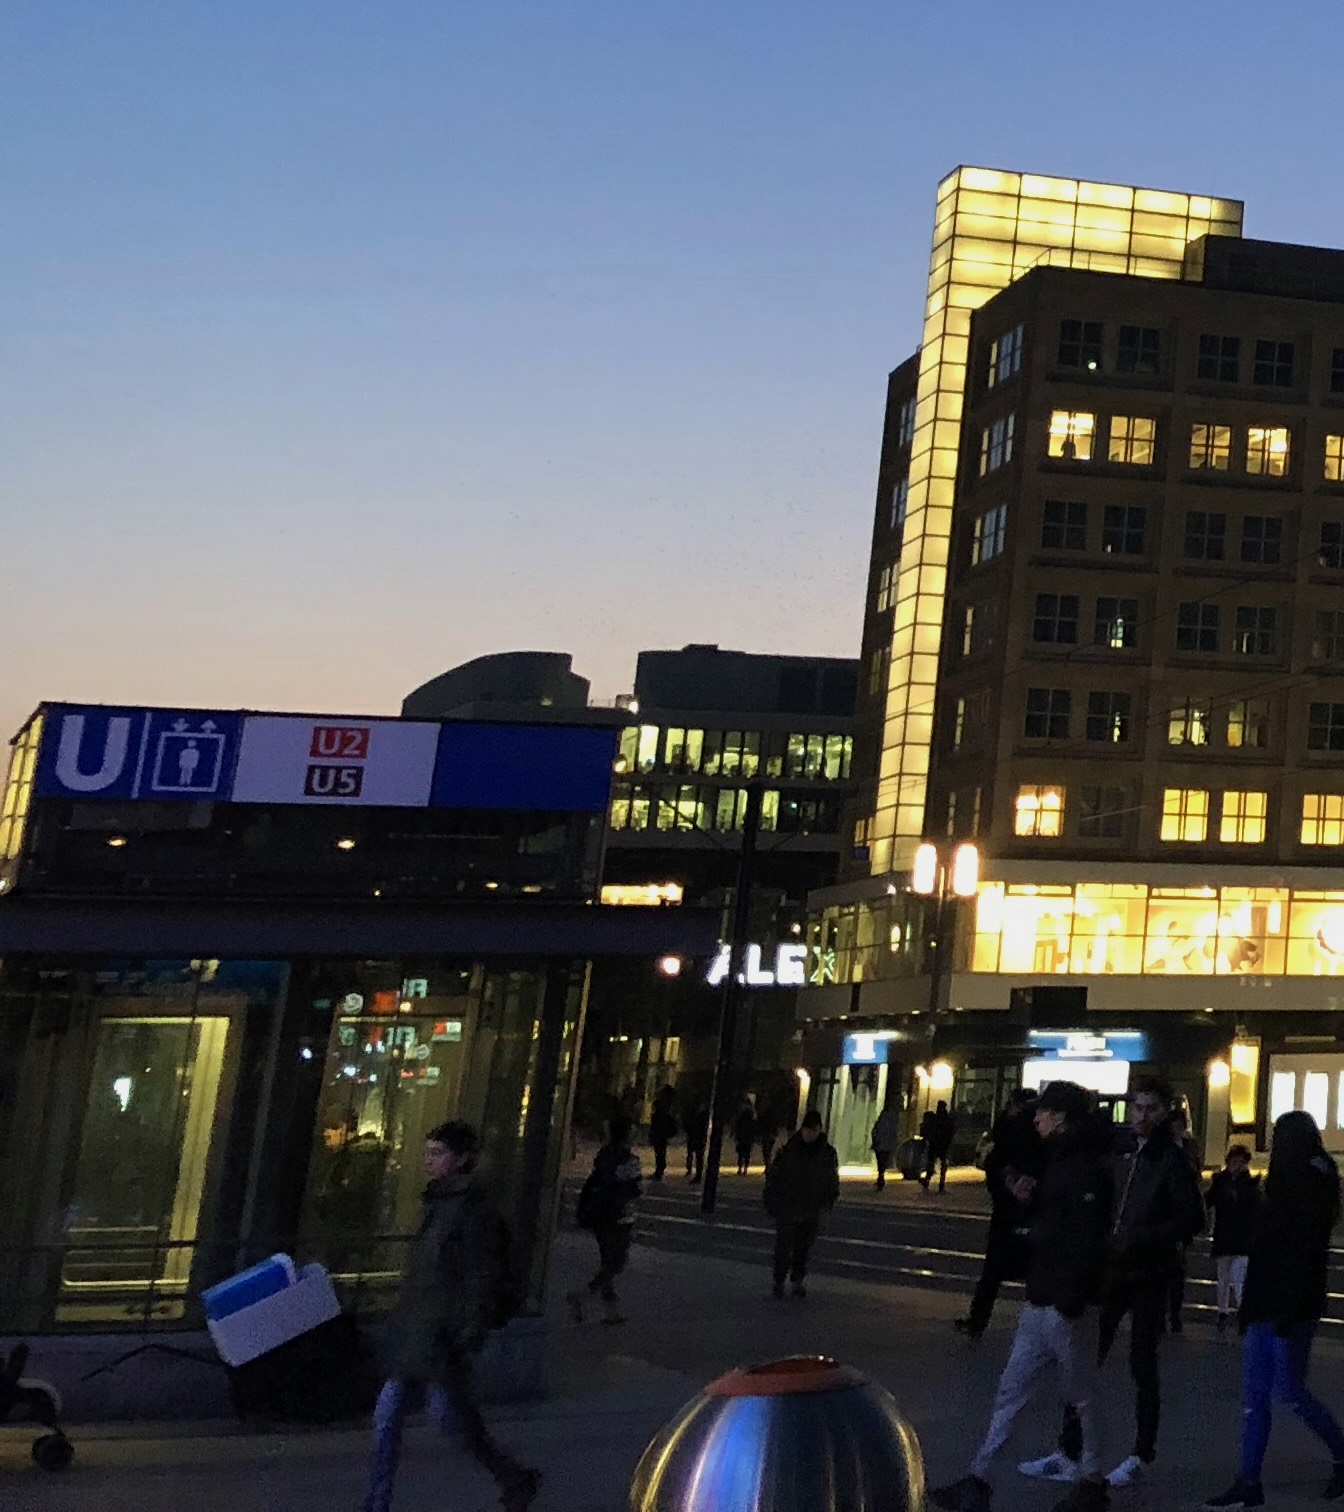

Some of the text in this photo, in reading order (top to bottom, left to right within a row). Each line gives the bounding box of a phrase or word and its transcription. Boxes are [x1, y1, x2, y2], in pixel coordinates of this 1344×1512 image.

[54, 714, 132, 792] U
[316, 729, 363, 756] U2
[311, 767, 358, 795] U5
